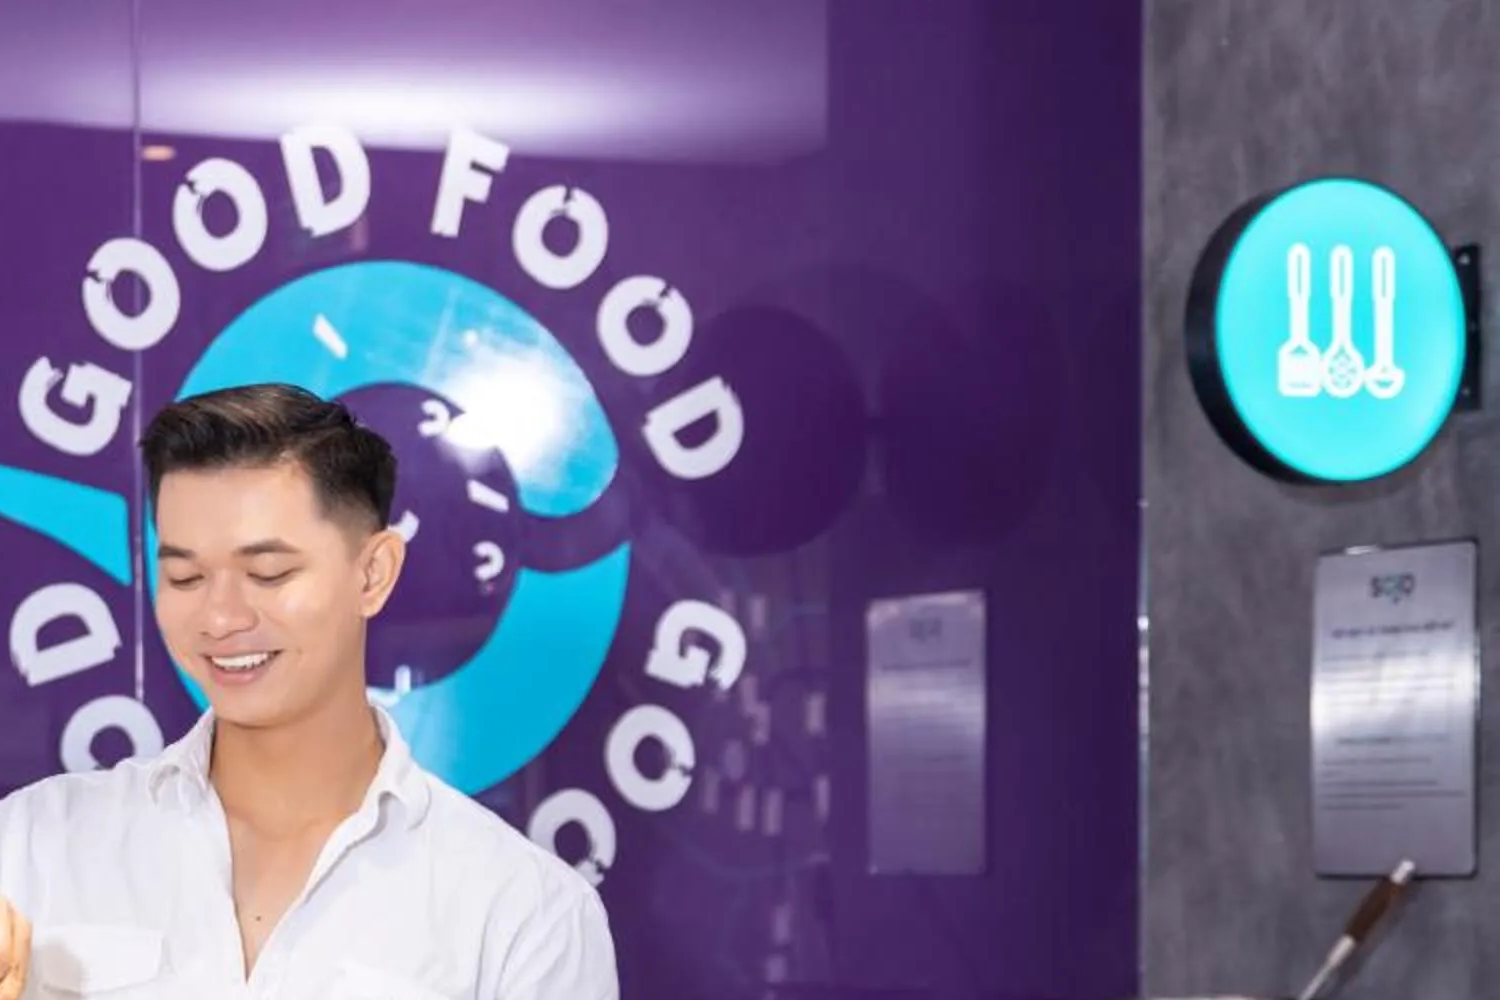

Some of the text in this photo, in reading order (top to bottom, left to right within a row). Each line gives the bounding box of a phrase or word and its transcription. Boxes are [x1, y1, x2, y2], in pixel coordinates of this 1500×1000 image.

[18, 122, 745, 480] GOOD FOOD
[527, 599, 747, 886] GOO
